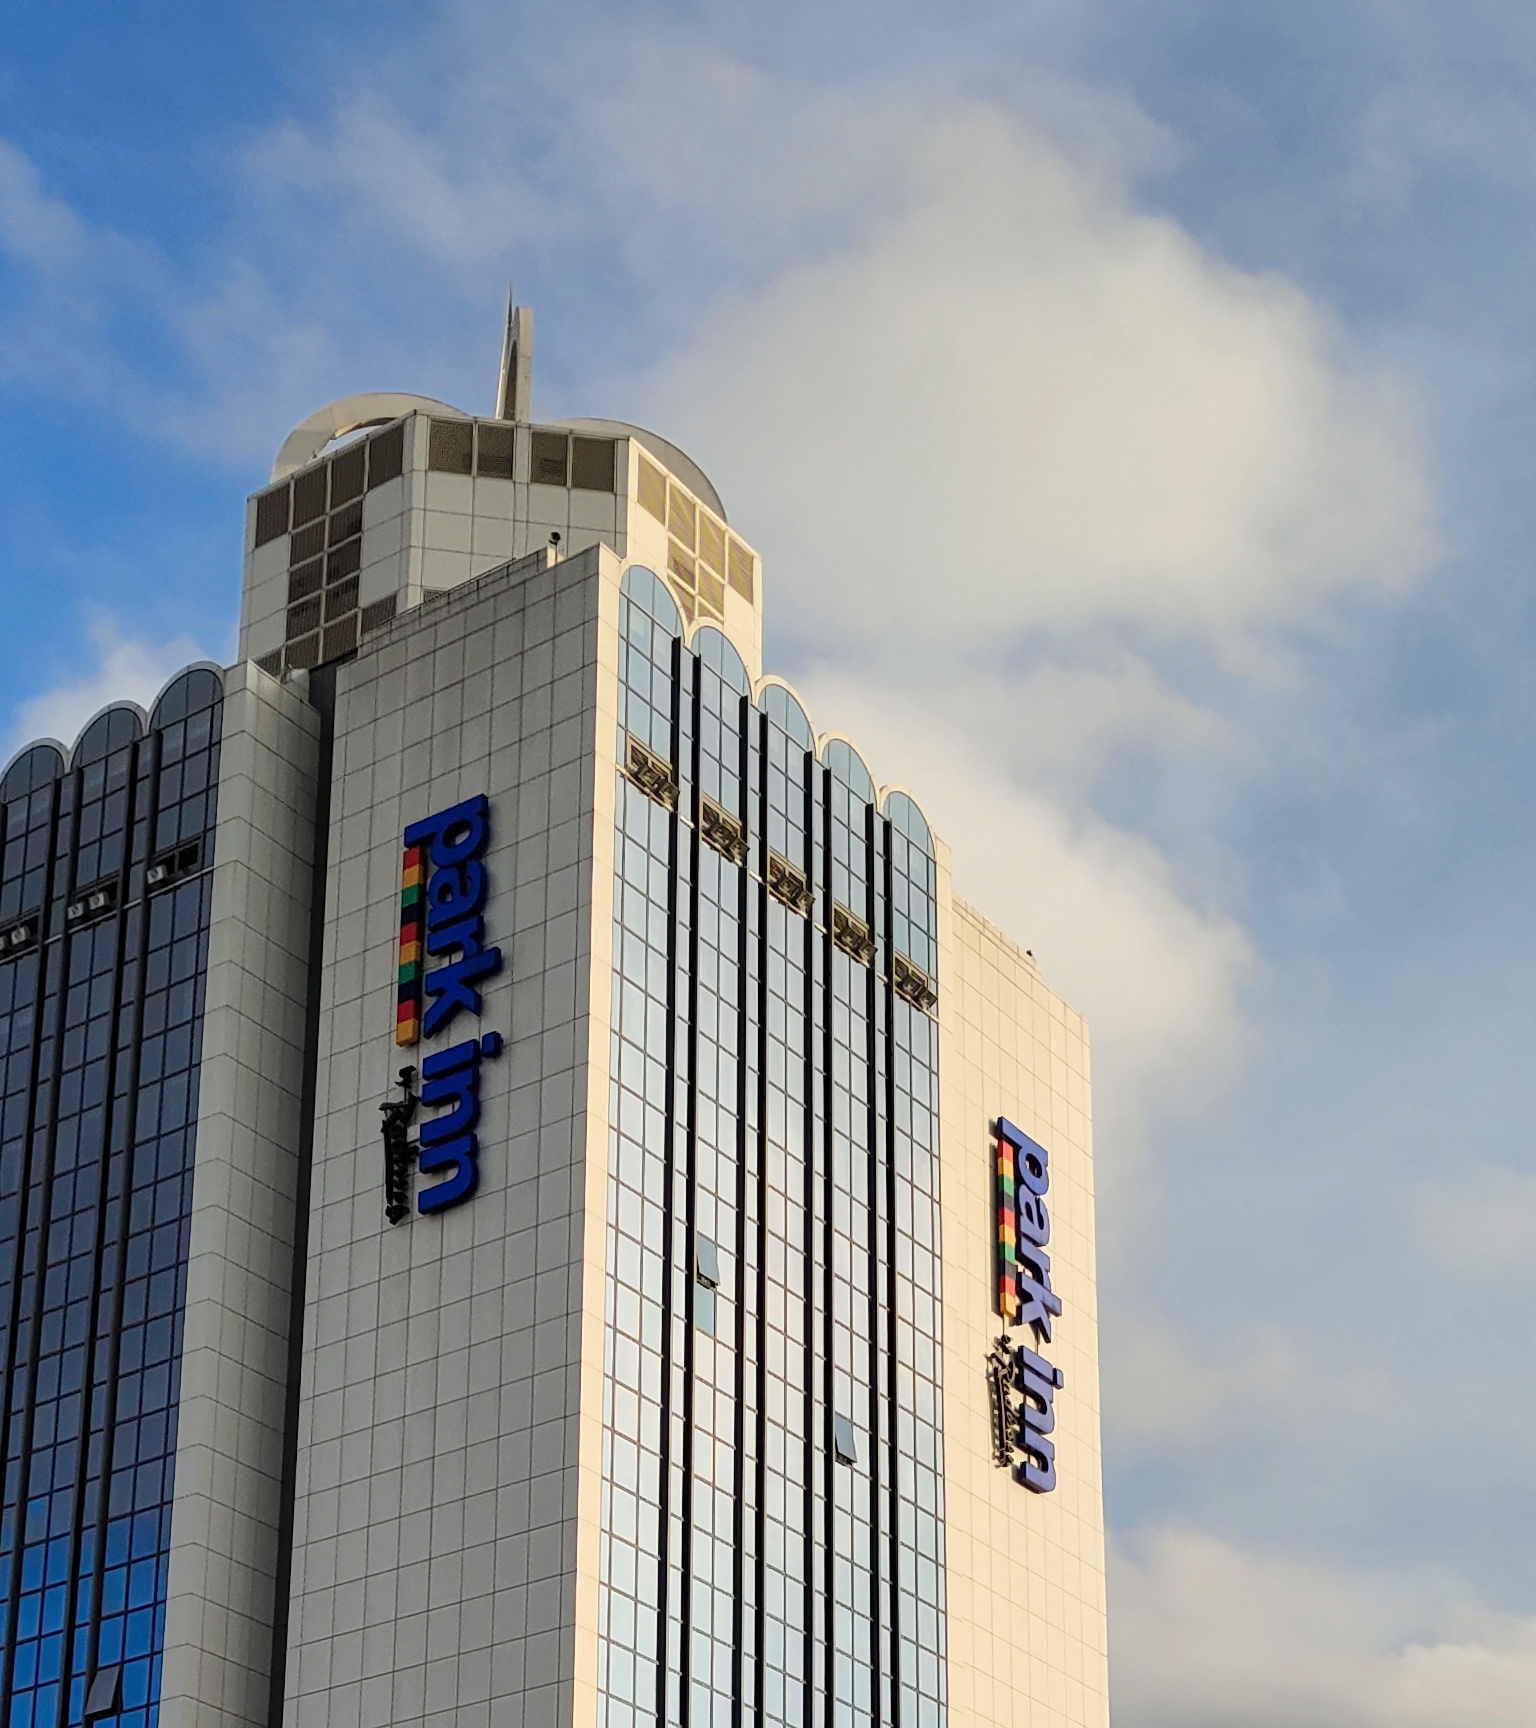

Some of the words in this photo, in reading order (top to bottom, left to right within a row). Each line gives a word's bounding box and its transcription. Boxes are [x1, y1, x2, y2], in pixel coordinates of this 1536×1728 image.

[403, 794, 502, 1040] park
[416, 1031, 503, 1216] inn
[995, 1116, 1062, 1345] park
[1017, 1345, 1064, 1495] inn
